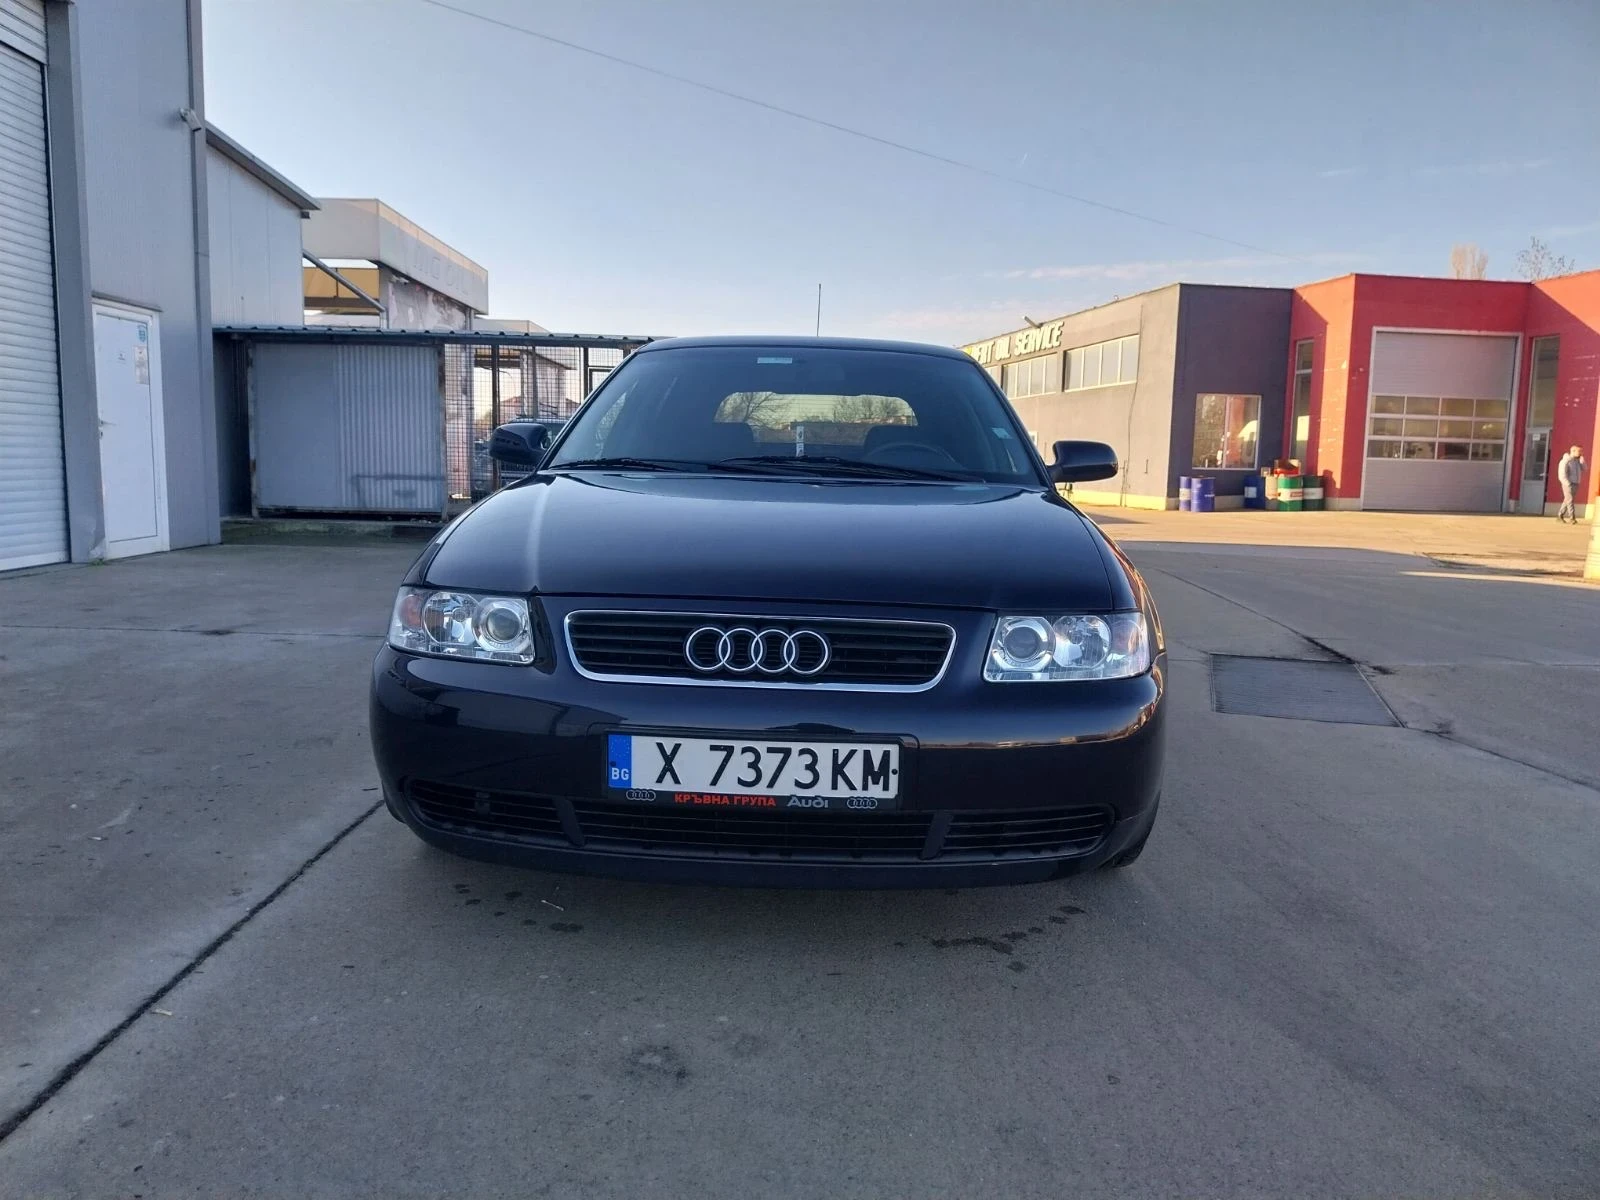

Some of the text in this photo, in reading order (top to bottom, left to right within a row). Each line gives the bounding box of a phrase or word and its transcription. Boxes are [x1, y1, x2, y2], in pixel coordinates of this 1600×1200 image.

[994, 336, 1011, 361] OIL
[1014, 320, 1064, 356] SERVICE
[611, 767, 630, 781] BG
[674, 792, 777, 807] КРЪВНА ГРУПА
[787, 795, 829, 808] Audi
